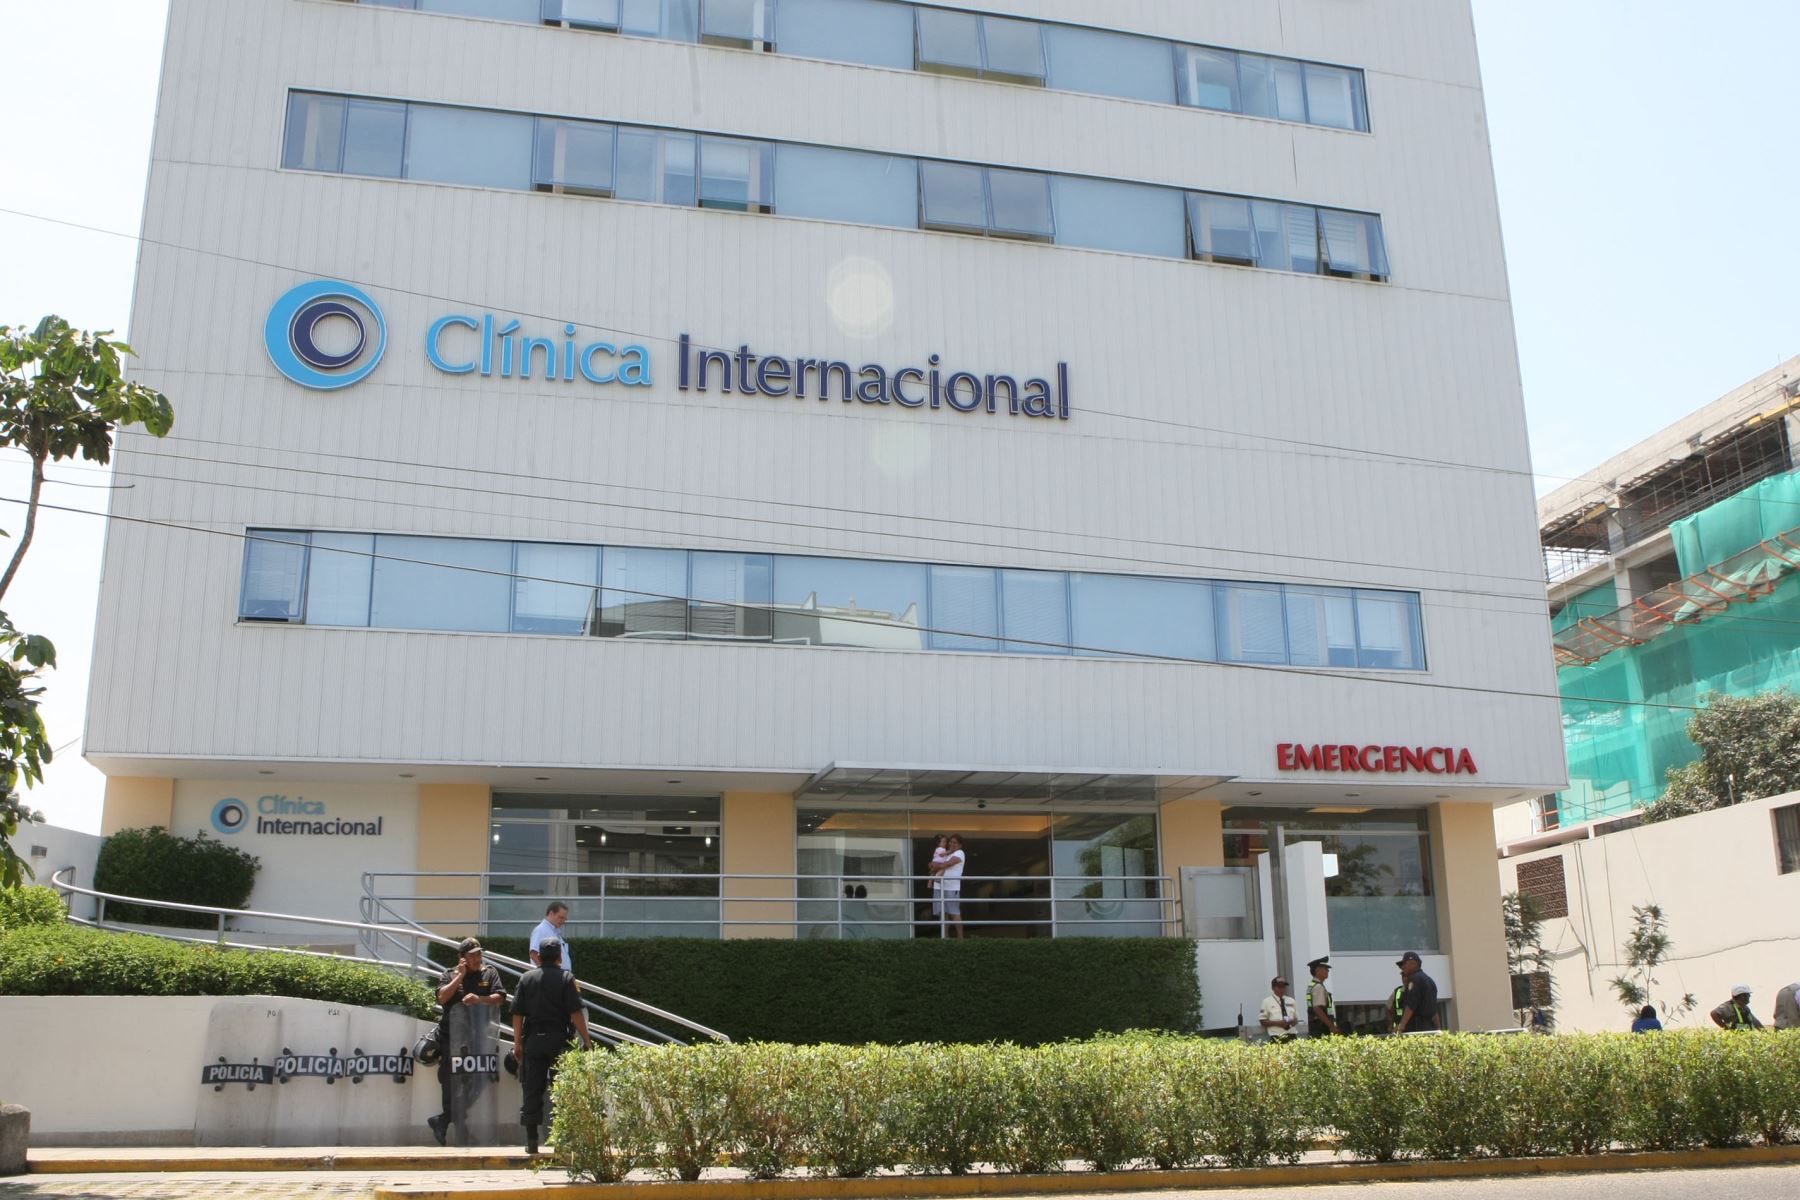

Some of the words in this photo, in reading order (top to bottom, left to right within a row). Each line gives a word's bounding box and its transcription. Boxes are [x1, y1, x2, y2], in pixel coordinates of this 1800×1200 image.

[425, 314, 653, 387] Clínica
[678, 333, 1070, 420] Internacional
[1277, 743, 1478, 774] EMERGENCIA
[257, 795, 325, 815] Clínica
[257, 816, 382, 836] Internacional
[209, 1066, 264, 1081] POLICIA
[275, 1057, 344, 1075] POLICIA
[346, 1056, 413, 1075] POLICIA
